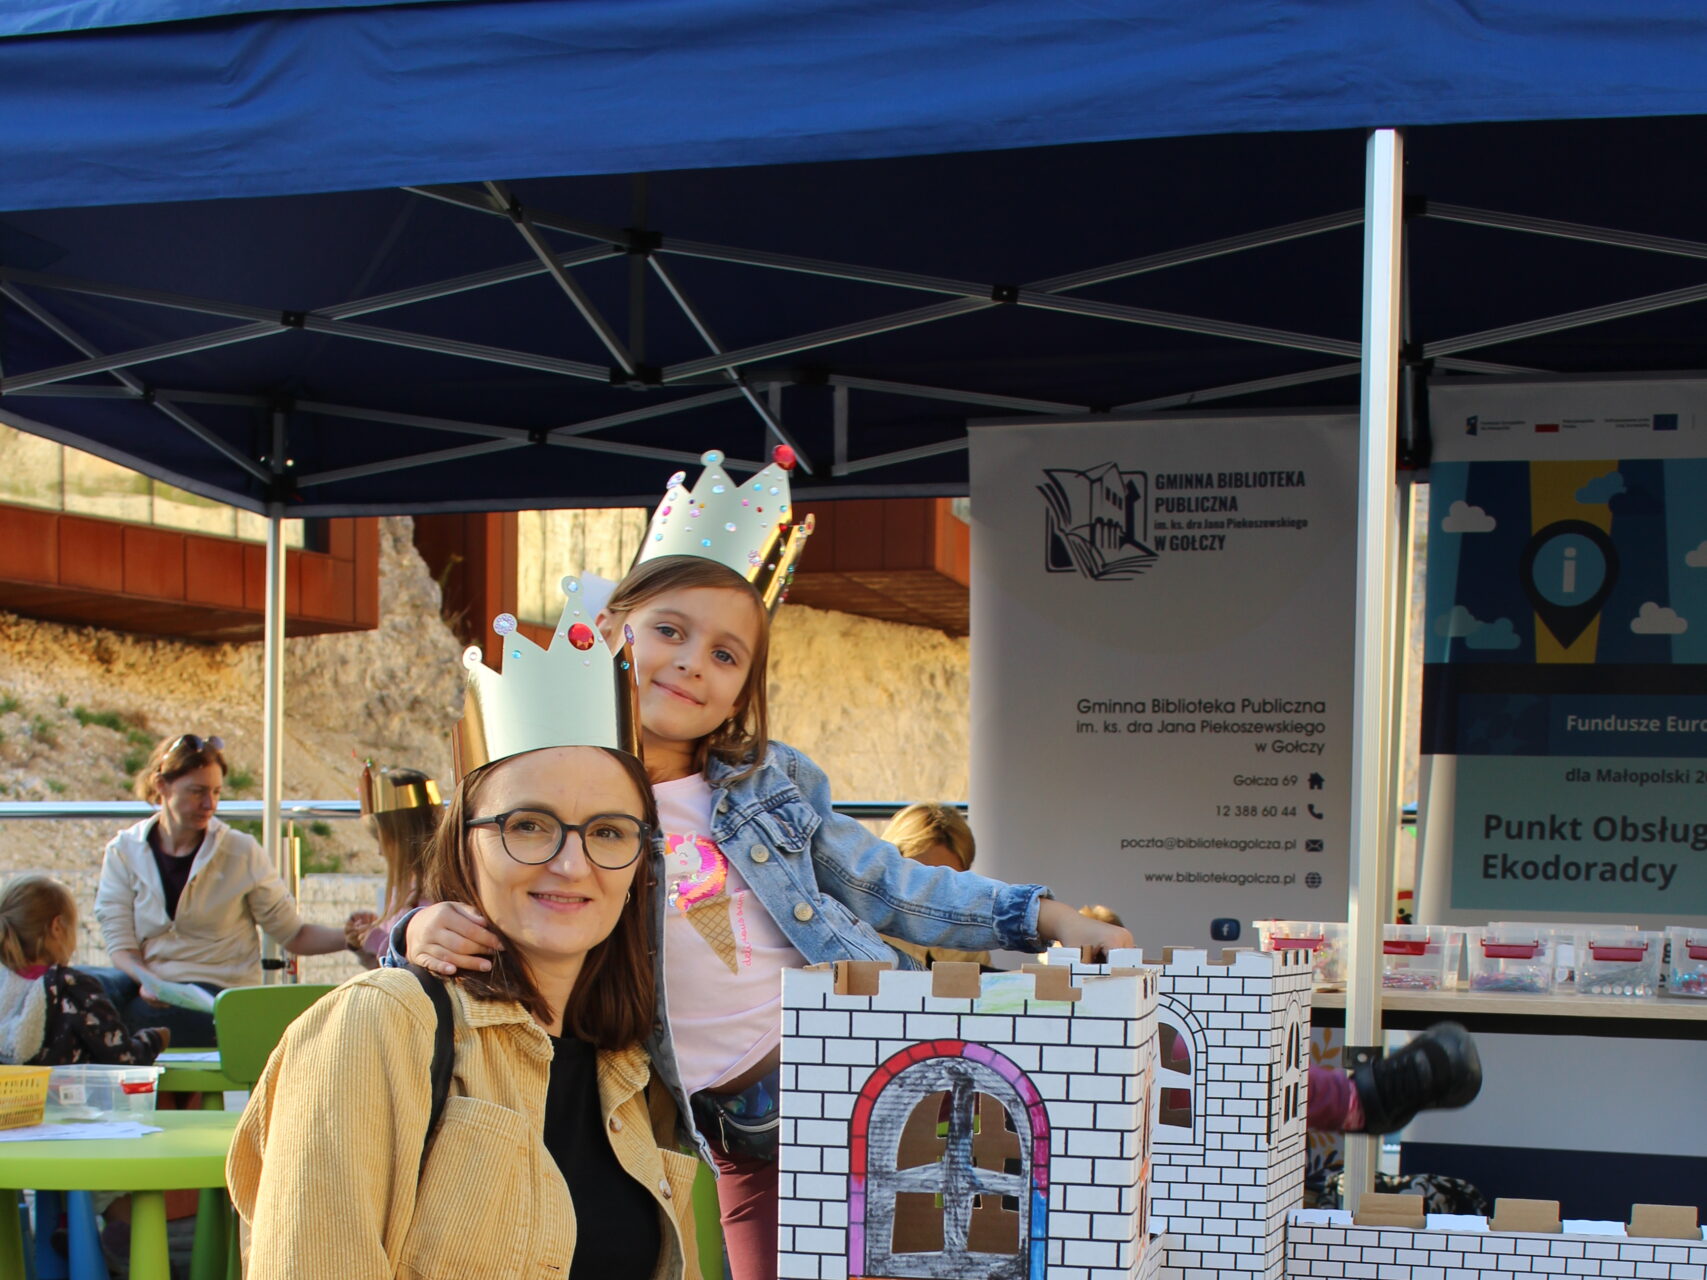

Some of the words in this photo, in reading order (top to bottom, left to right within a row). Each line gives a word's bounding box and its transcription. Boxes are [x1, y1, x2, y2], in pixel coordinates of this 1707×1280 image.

[1155, 473, 1214, 490] GMINNA
[1217, 471, 1305, 488] BIBLIOTEKA
[1155, 496, 1238, 513] PUBLICZNA
[1154, 536, 1167, 550] W
[1169, 535, 1226, 550] GOŁCZY
[1077, 699, 1146, 714] Gminna
[1152, 699, 1236, 714] Biblioteka
[1241, 699, 1326, 714] Publiczna
[1076, 720, 1099, 733] im.
[1103, 720, 1121, 733] ks.
[1127, 720, 1152, 733] dra
[1157, 720, 1196, 734] Jana
[1200, 720, 1326, 737] Piekoszewskiego
[1566, 714, 1660, 732] Fundusze
[1255, 742, 1267, 752] w
[1272, 739, 1326, 756] Gołczy
[1233, 774, 1279, 787] Gołcza
[1282, 775, 1298, 787] 69
[1565, 768, 1591, 782] dla
[1596, 768, 1690, 787] Małopolski
[1695, 771, 1707, 784] 2
[1216, 805, 1231, 817] 12
[1234, 805, 1258, 817] 388
[1261, 805, 1277, 817] 60
[1281, 805, 1297, 817] 44
[1483, 814, 1583, 841] Punkt
[1120, 836, 1297, 851] poczta@bibliotekagolcza.pl
[1145, 871, 1296, 886] www.bibliotekagolcza.pl
[1482, 853, 1678, 891] Ekodoradcy
